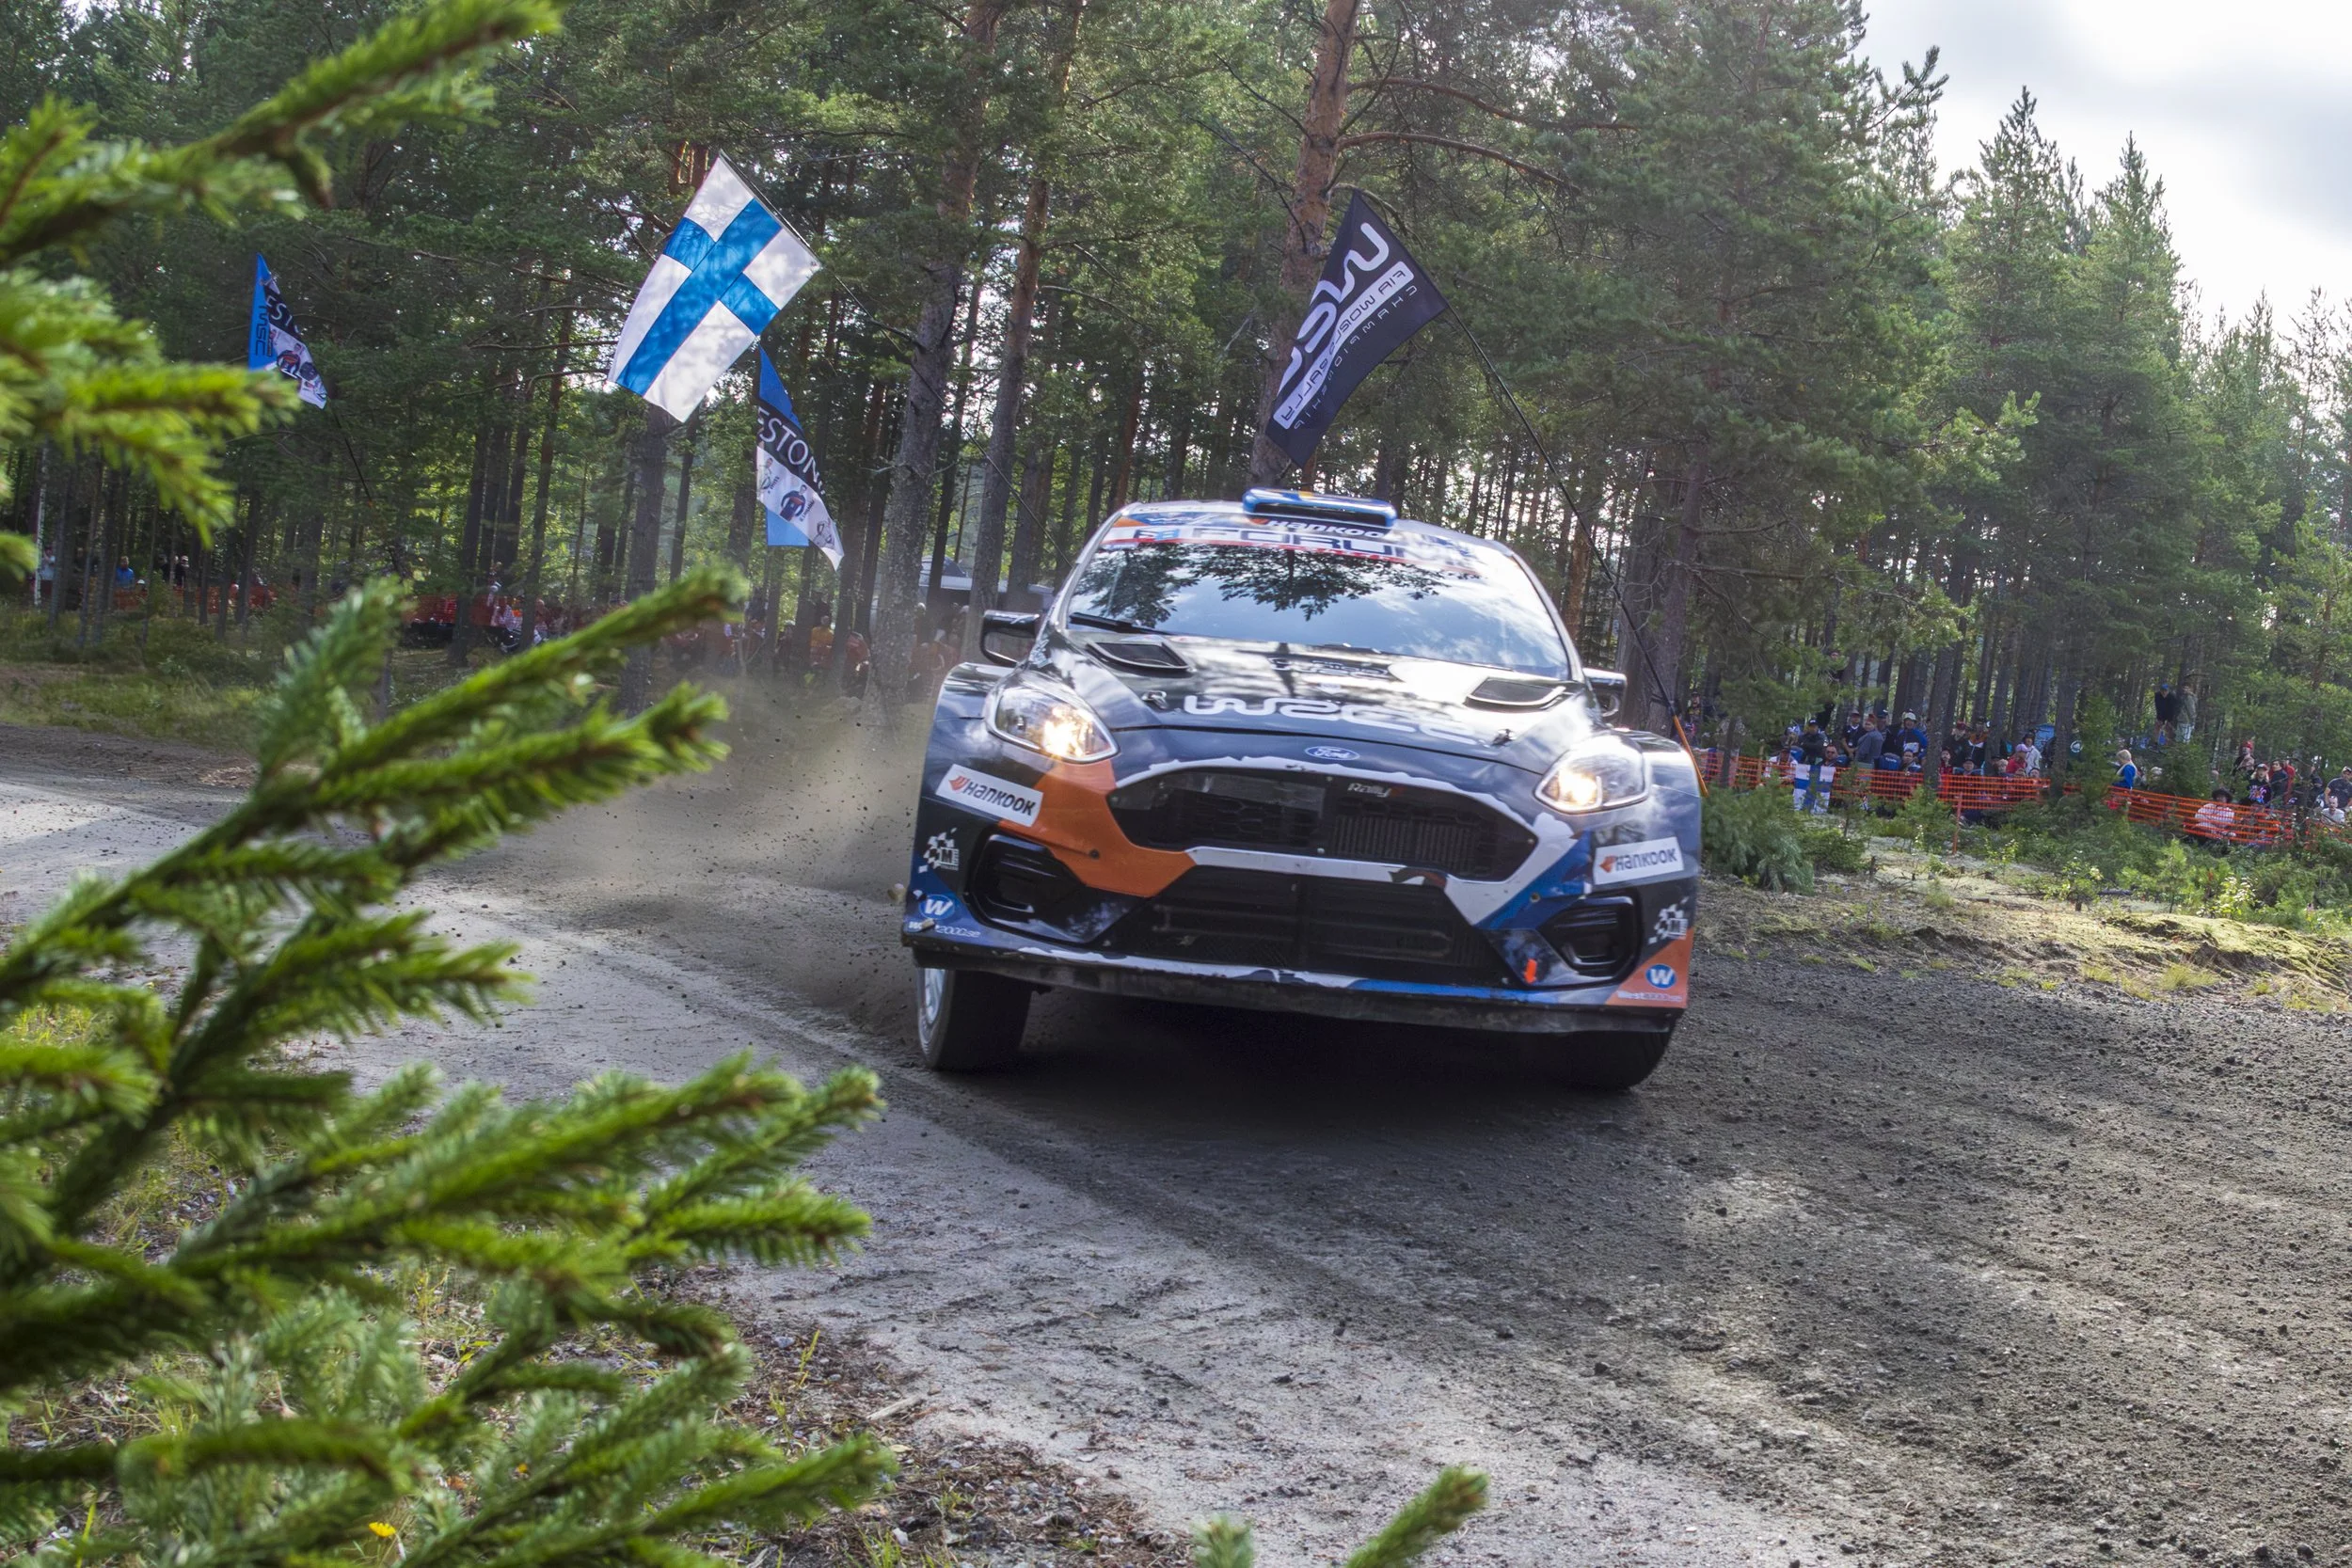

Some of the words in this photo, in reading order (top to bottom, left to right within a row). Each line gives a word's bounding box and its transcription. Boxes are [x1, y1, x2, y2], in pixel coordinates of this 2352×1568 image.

[757, 405, 826, 495] ESTON
[1313, 746, 1351, 759] Ford
[924, 899, 953, 915] W
[1650, 968, 1675, 985] W
